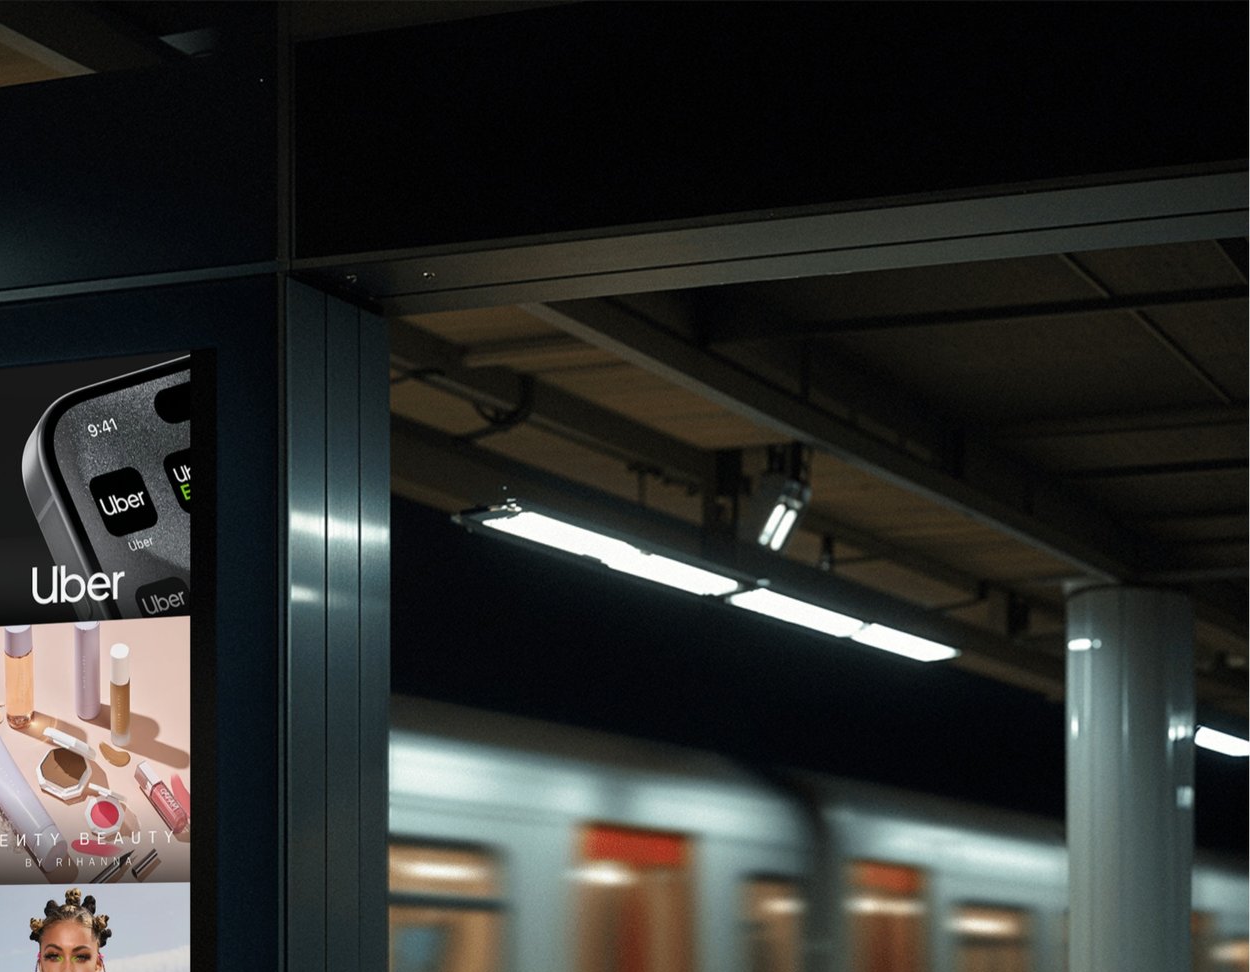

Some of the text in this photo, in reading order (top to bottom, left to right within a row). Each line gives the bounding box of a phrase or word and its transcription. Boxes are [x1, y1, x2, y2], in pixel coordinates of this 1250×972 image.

[87, 417, 118, 438] 9:41
[99, 491, 146, 516] Uber
[127, 537, 154, 552] Uber
[31, 565, 126, 605] Uber
[141, 591, 187, 615] Uber
[79, 830, 175, 846] BEAUTY
[25, 856, 134, 868] BY RIHANNA
